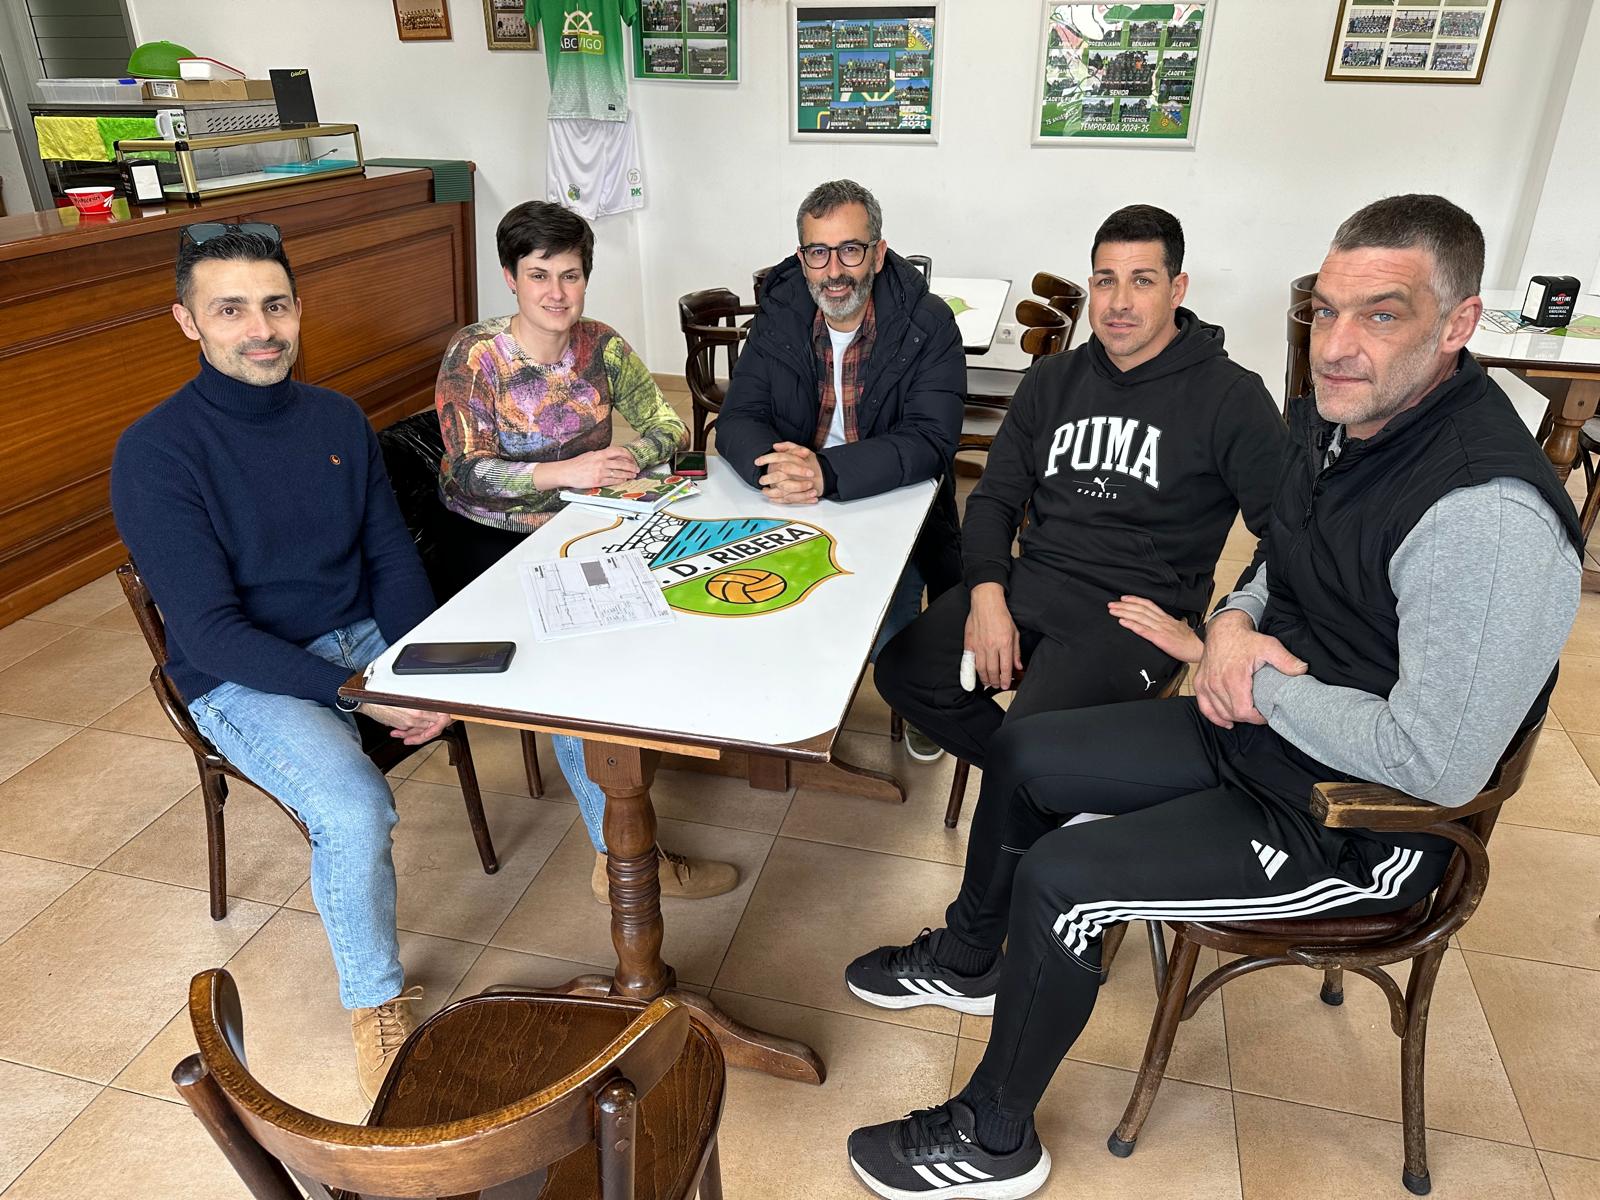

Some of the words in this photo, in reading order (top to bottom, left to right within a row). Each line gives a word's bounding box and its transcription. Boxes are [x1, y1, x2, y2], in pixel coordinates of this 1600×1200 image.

[1080, 122, 1120, 132] TEMPORADA
[1121, 123, 1150, 133] 2024-25
[1044, 415, 1162, 491] PUMA
[1076, 488, 1118, 500] SPORTS
[707, 527, 815, 564] RIBERA
